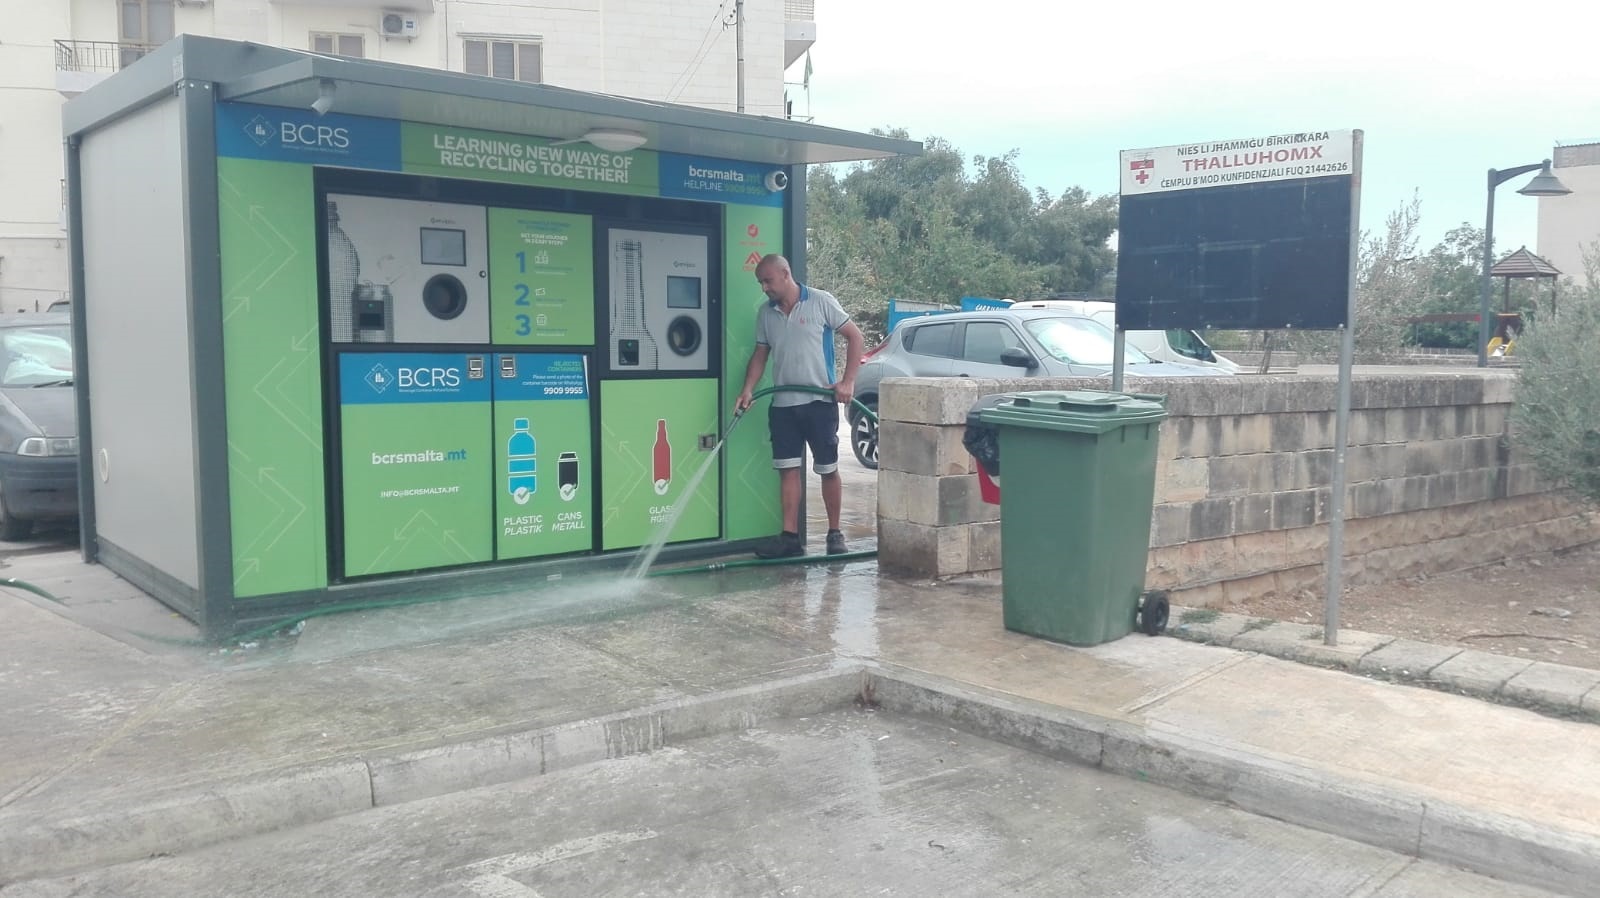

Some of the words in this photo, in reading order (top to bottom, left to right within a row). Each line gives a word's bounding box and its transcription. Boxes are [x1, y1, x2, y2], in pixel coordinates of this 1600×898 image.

[281, 122, 350, 148] BCRS
[433, 133, 523, 157] LEARNING
[526, 145, 563, 162] NEW
[567, 149, 610, 168] WAYS
[612, 155, 633, 169] OF
[1177, 146, 1199, 156] NIES
[1201, 144, 1209, 154] LI
[440, 150, 538, 174] RECYCLING
[540, 161, 629, 183] TOGETHER!
[1221, 168, 1284, 182] KUNFIDENZJALI
[1286, 166, 1303, 176] FUQ
[1305, 162, 1348, 174] 21442626
[684, 179, 724, 192] HELPLINE
[515, 251, 527, 273] 1
[514, 283, 531, 307] 2
[514, 313, 532, 337] 3
[398, 367, 460, 387] BCRS
[543, 387, 564, 395] 9909
[565, 386, 584, 394] 9955
[372, 449, 467, 465] bcrsmalta.mt
[380, 486, 460, 498] INFO@BCRSMALTA.MT
[503, 514, 543, 526] PLASTIC
[557, 511, 583, 521] CANS
[504, 524, 544, 536] PLASTIK
[551, 521, 586, 532] METALL
